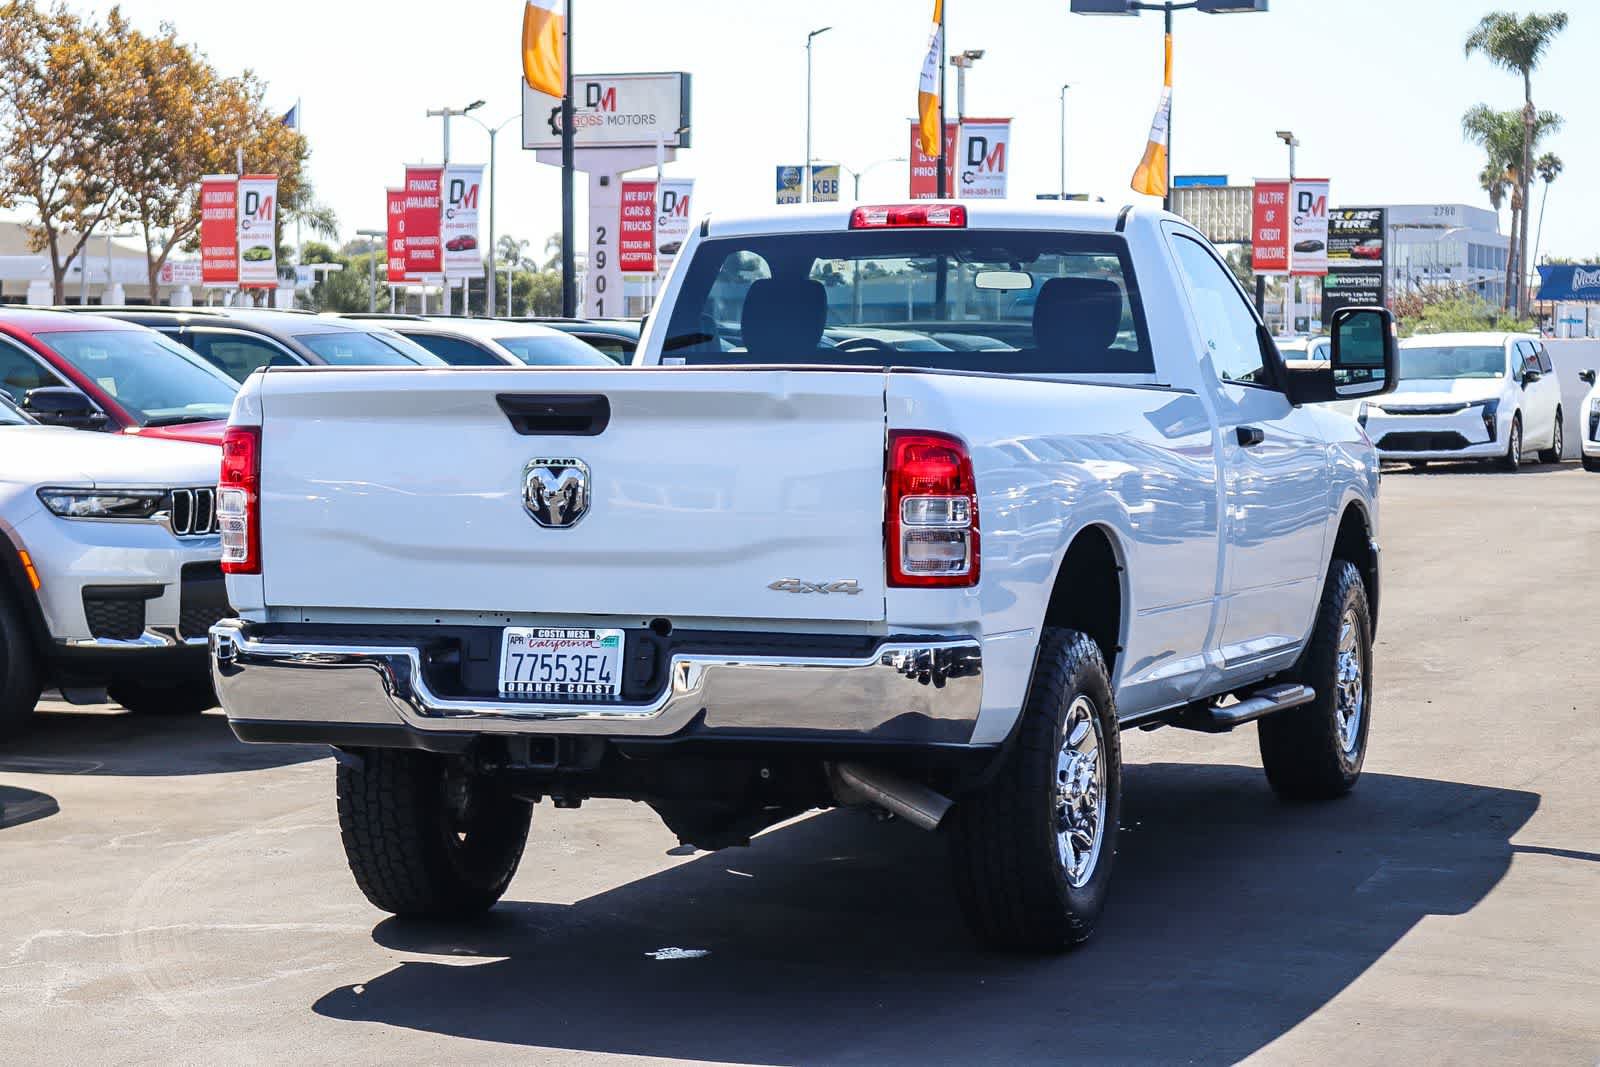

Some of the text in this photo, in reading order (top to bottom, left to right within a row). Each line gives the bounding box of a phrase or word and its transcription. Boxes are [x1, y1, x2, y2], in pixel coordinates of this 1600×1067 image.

[586, 83, 616, 112] DM
[607, 113, 656, 125] MOTORS
[968, 136, 1005, 172] DM
[410, 180, 437, 190] FINANCE
[812, 180, 839, 194] KBB
[450, 179, 479, 209] DM
[625, 191, 654, 201] WE BUY
[1258, 192, 1284, 204] ALL TYPE
[245, 191, 273, 221] DM
[406, 196, 439, 208] AVAILABLE
[662, 191, 690, 217] DM
[1298, 192, 1326, 217] DM
[625, 206, 644, 216] CARS
[1265, 210, 1275, 222] OF
[623, 221, 651, 232] TRUCKS
[1335, 220, 1371, 229] TIRE
[1259, 228, 1280, 240] CREDIT
[1255, 247, 1285, 259] WELCOME
[1326, 276, 1381, 286] enterprise
[767, 577, 864, 595] 4x4
[538, 630, 590, 638] COSTA MESA
[510, 636, 524, 645] APR
[528, 639, 598, 652] California
[511, 653, 611, 683] 77553E4
[508, 683, 611, 693] ORANGE COAST
